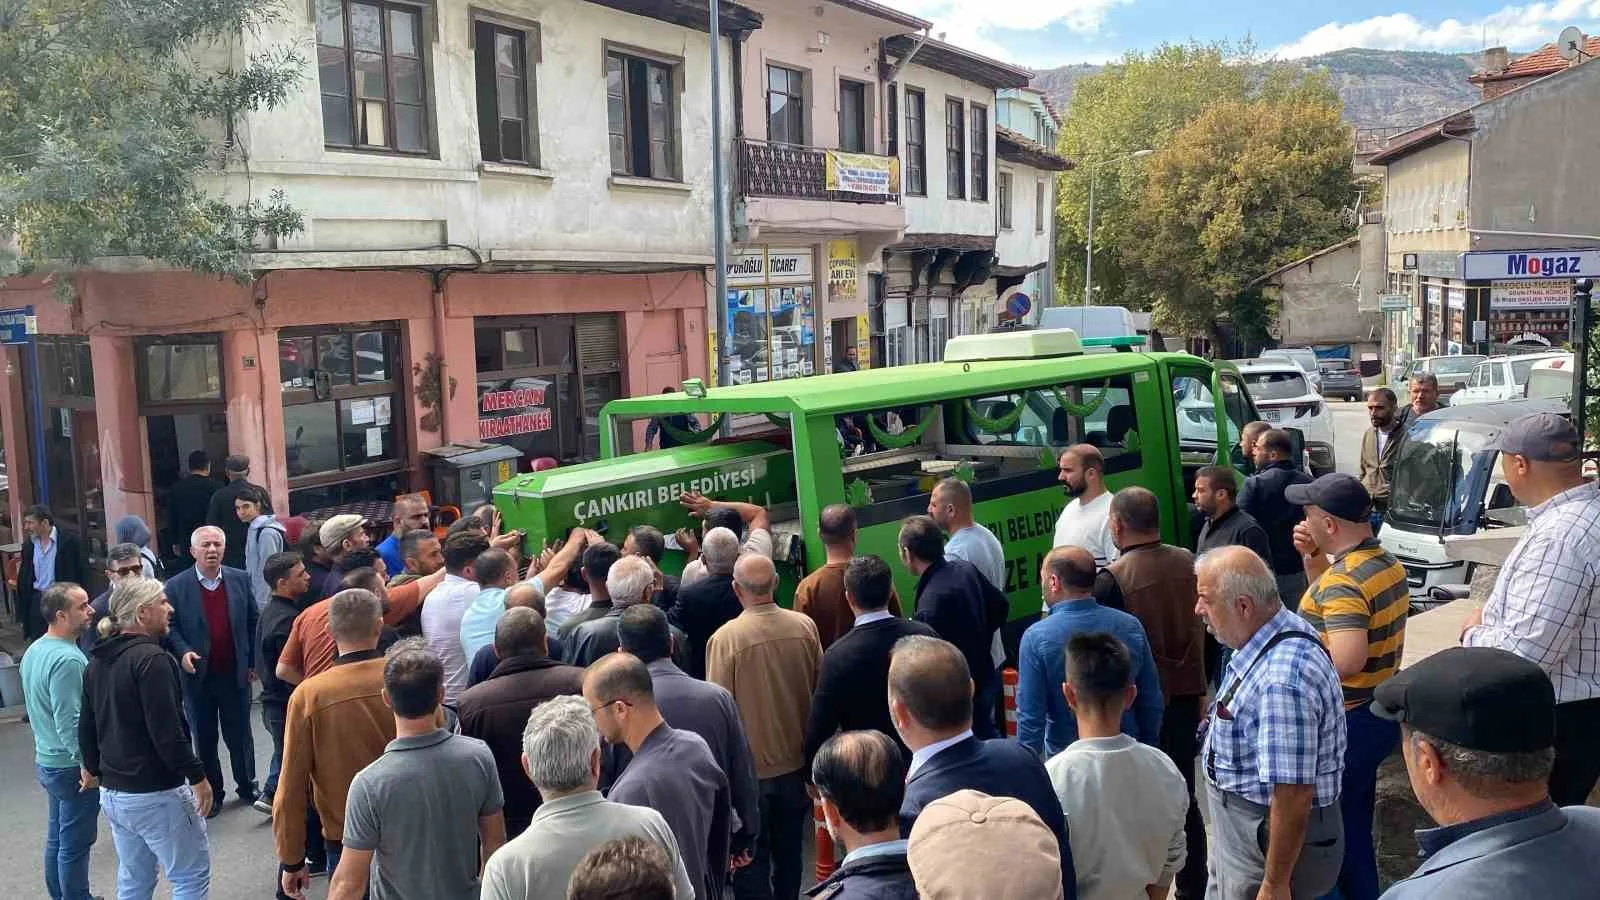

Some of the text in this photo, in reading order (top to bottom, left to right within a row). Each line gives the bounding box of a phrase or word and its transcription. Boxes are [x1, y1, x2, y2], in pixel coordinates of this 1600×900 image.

[770, 256, 797, 273] TİCARET
[1507, 254, 1581, 277] Mogaz
[483, 389, 544, 411] MERCAN
[479, 408, 552, 440] KIRAATHANESİ
[574, 489, 653, 526] ÇANKIRI
